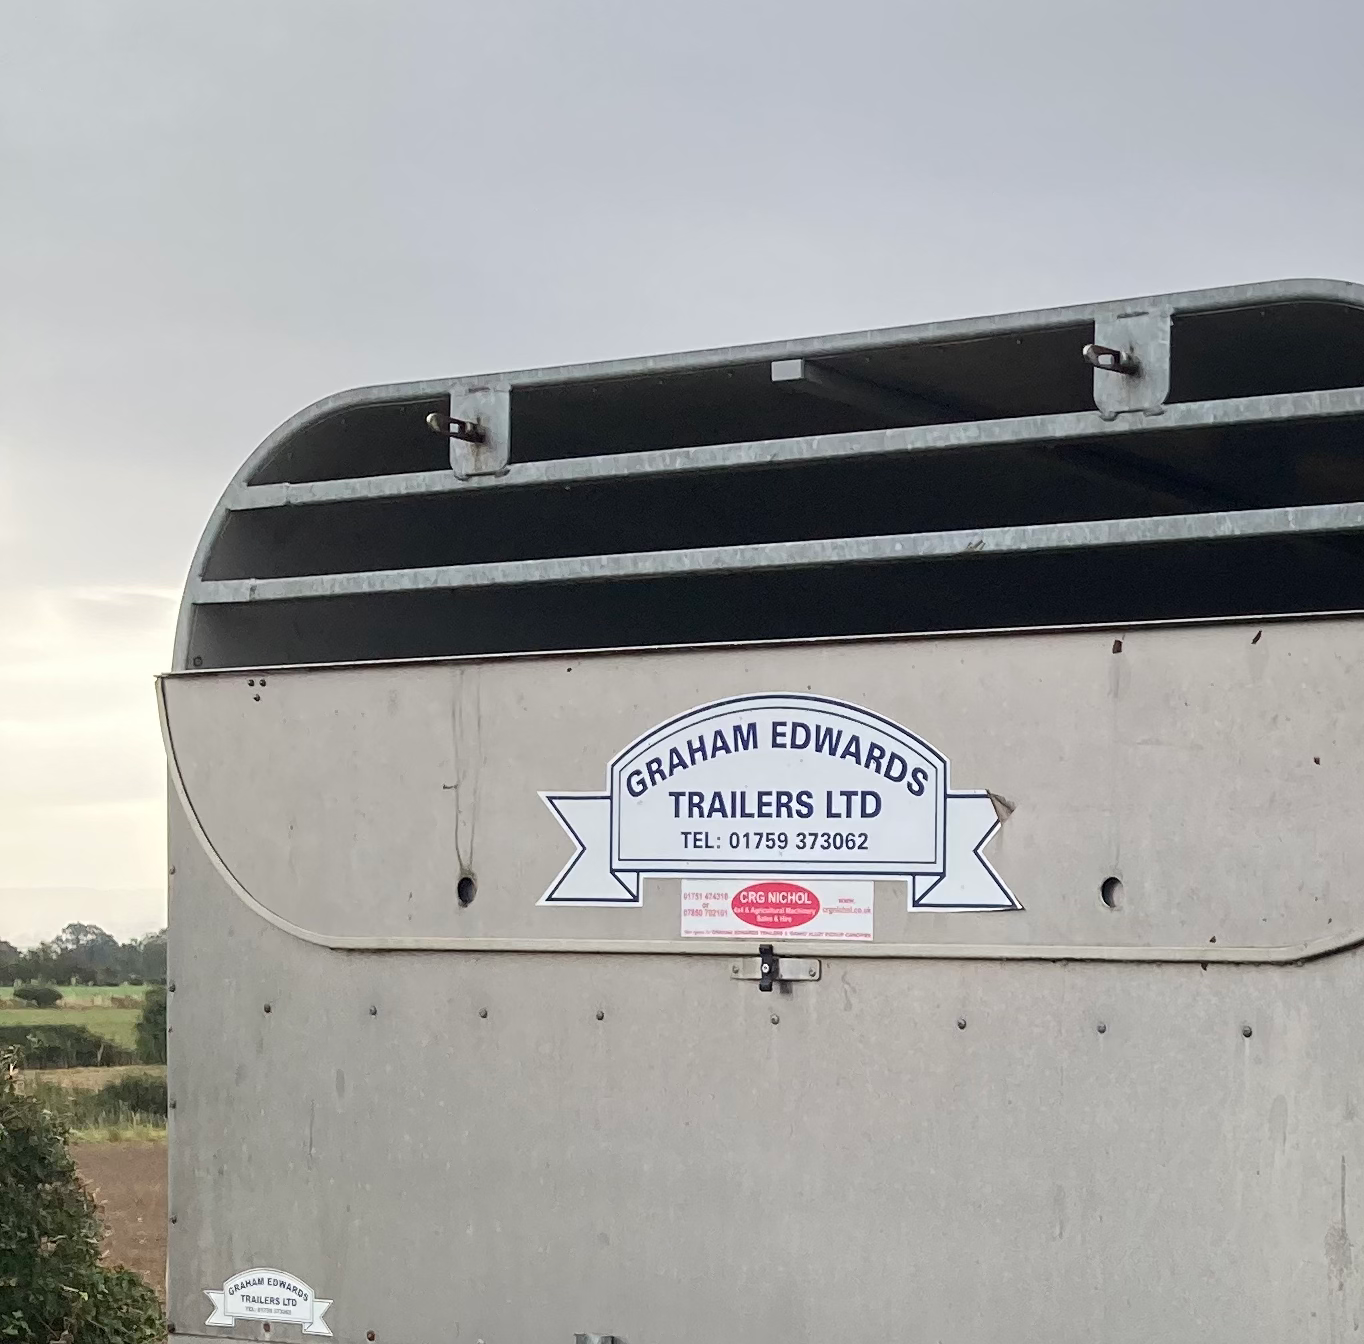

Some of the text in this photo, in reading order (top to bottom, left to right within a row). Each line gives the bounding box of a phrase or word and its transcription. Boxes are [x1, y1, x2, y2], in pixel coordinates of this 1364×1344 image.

[626, 721, 929, 797] GRAHAM EDWARDS
[668, 790, 882, 818] TRAILERS LTD
[680, 831, 869, 850] TEL: 01759 373062
[740, 891, 812, 904] CRG NICHOL
[228, 1277, 309, 1301] GRAHAM EDWARDS
[240, 1294, 298, 1307] TRAILERS LTD
